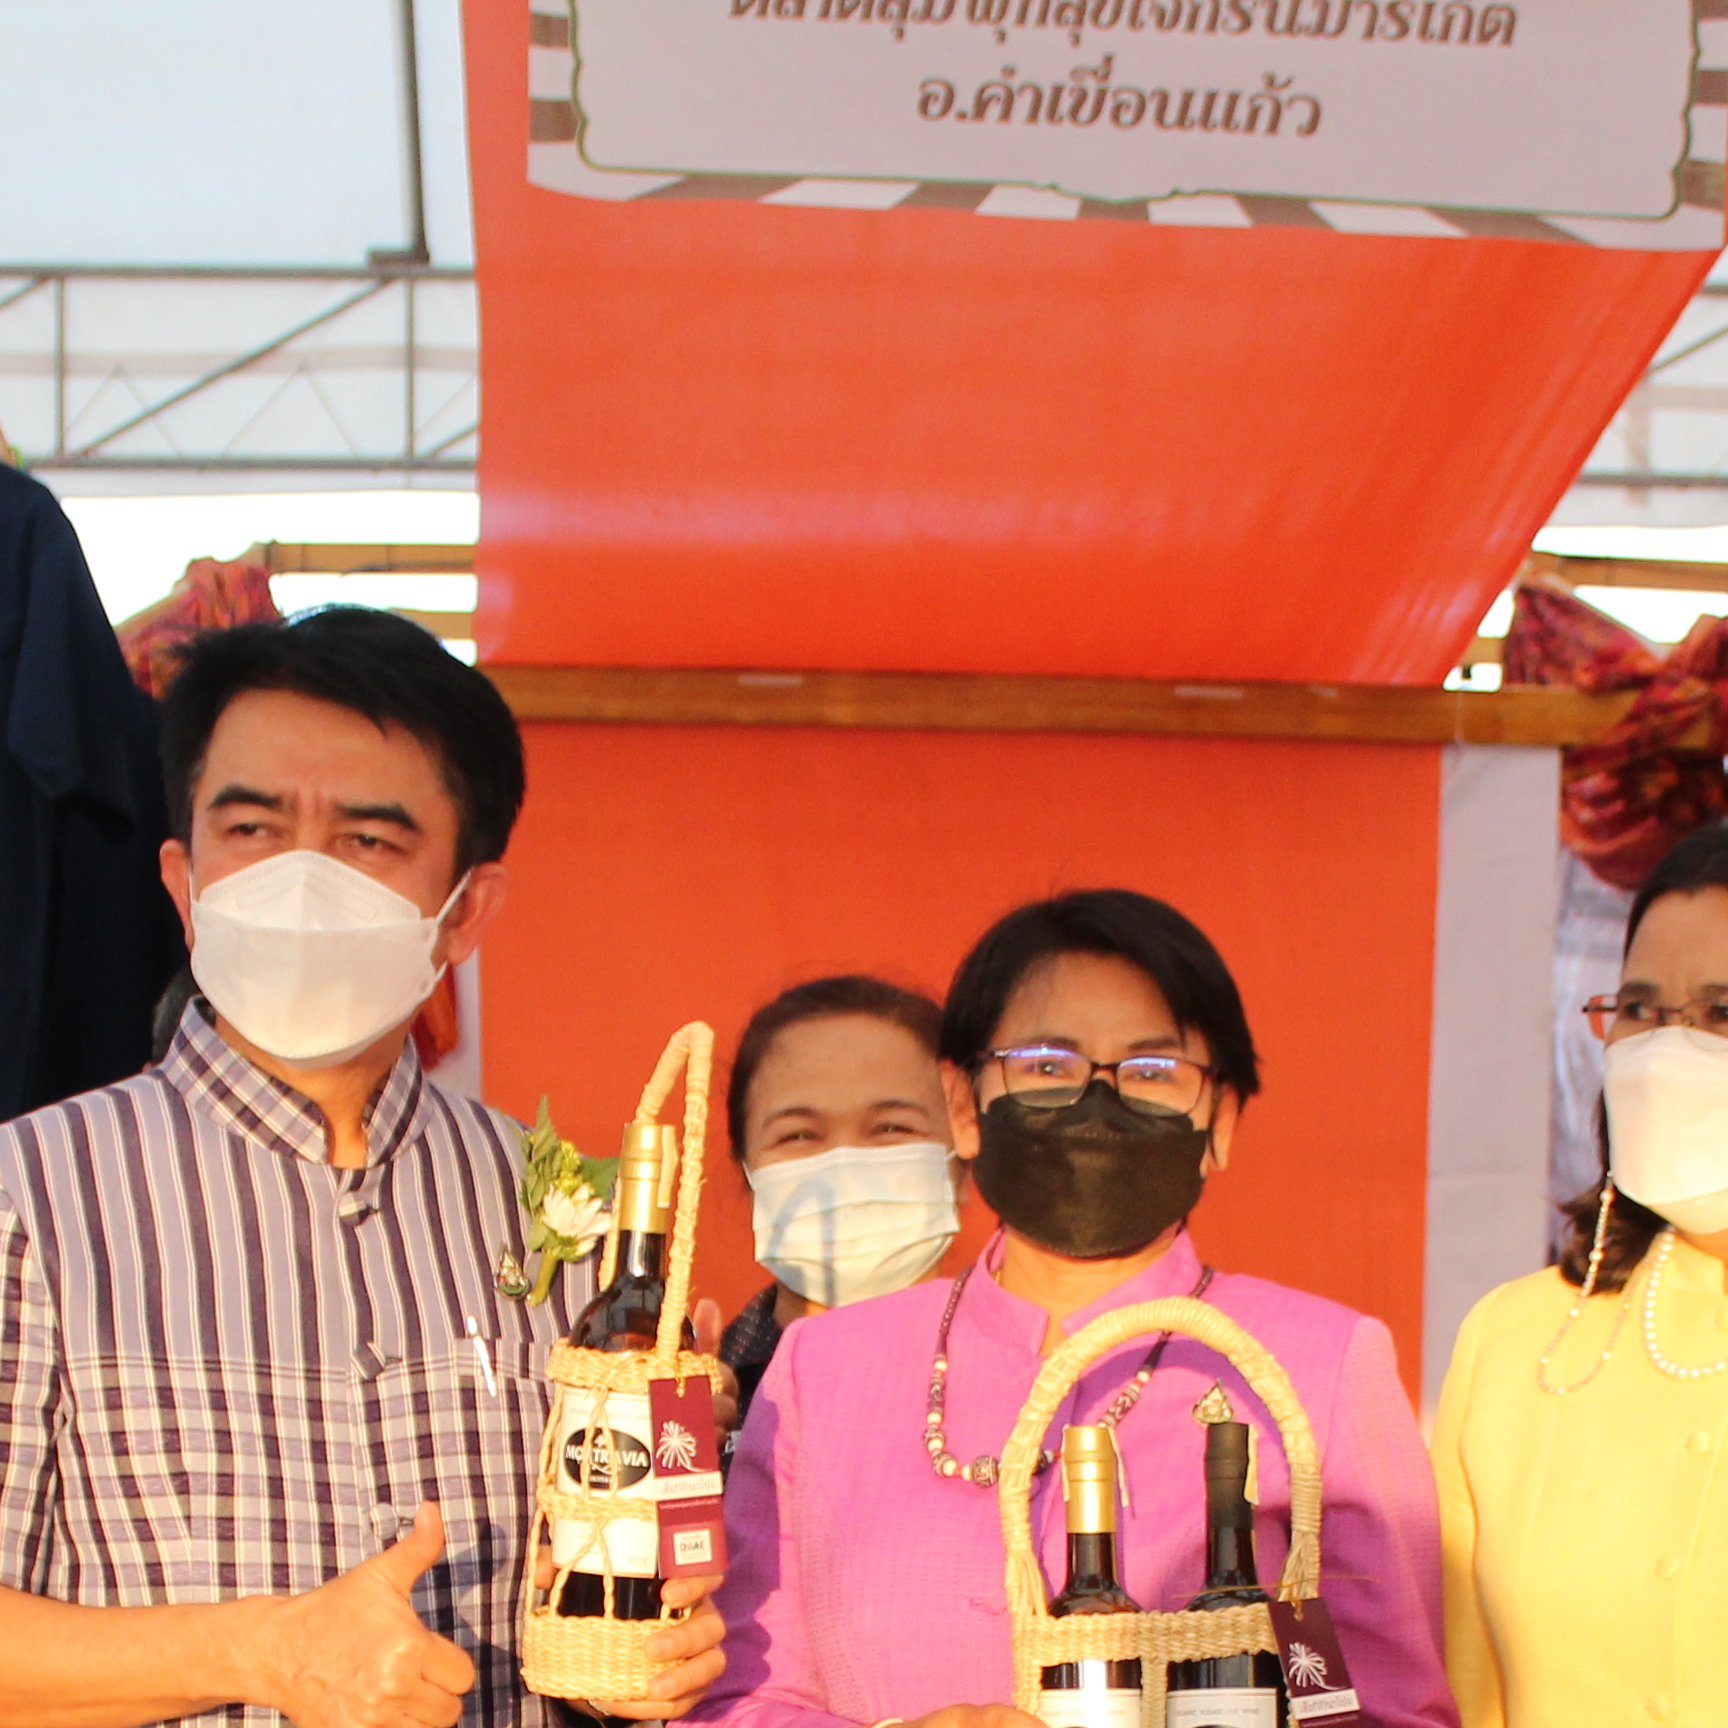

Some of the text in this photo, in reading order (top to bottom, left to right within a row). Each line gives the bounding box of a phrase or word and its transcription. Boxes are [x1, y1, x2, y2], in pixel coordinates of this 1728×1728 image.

[916, 53, 1323, 138] อ.คำเขื่อนแก้ว
[565, 1445, 648, 1468] MOTRVIA
